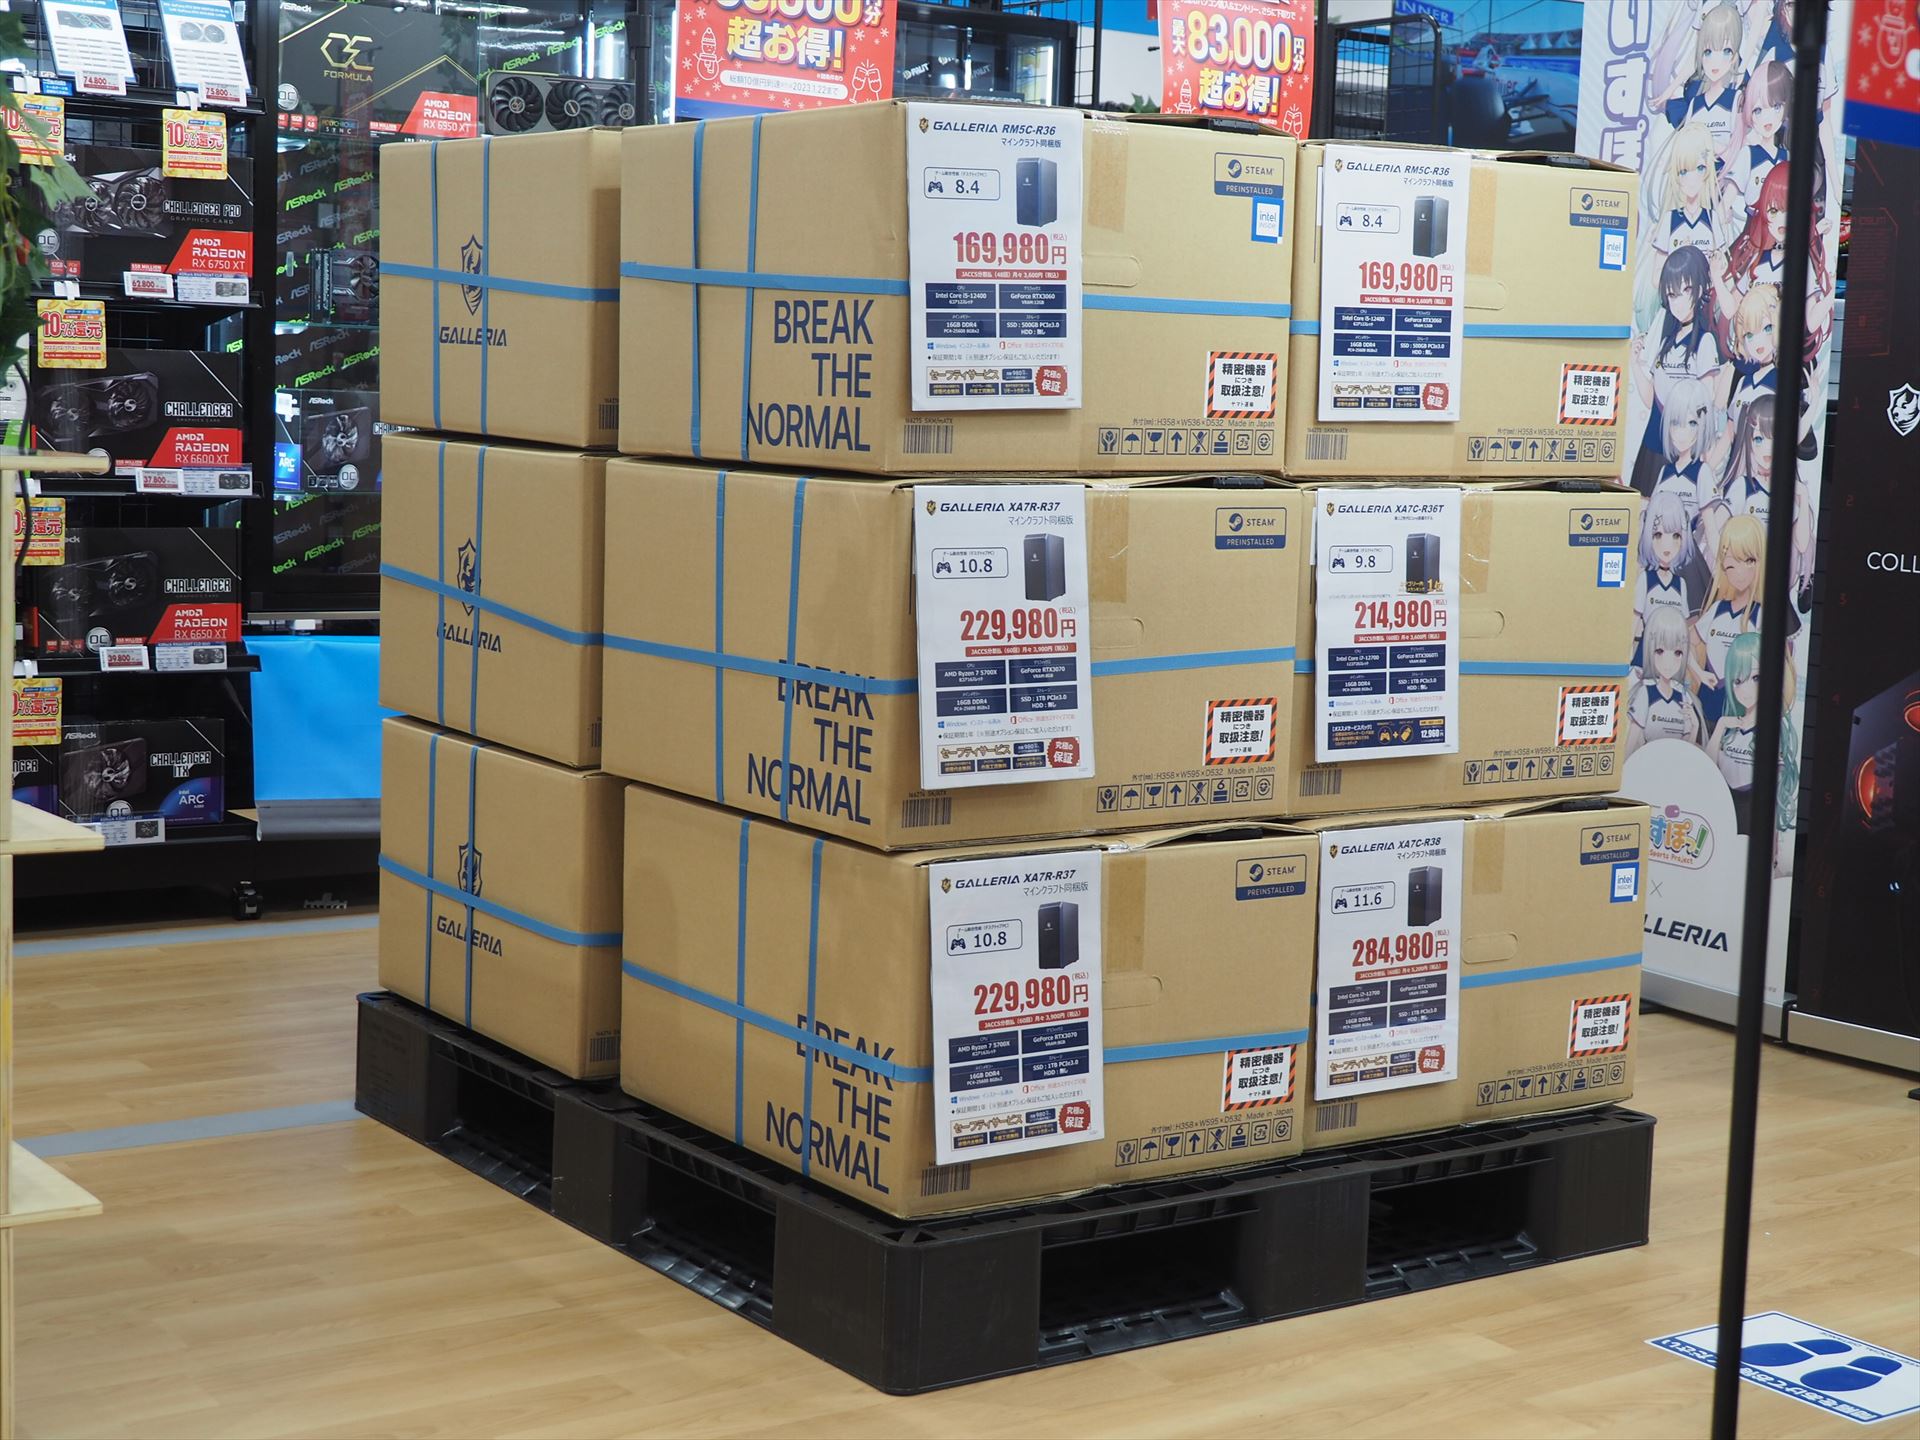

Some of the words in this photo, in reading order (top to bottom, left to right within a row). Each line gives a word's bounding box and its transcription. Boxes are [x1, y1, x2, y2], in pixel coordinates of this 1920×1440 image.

[280, 2, 312, 14] ASRock
[1172, 19, 1185, 54] 最大
[1187, 10, 1292, 74] 83,000
[728, 16, 844, 70] 超お得!
[1293, 37, 1305, 73] 円分
[502, 52, 541, 71] ASRock
[323, 70, 373, 82] FORMULA
[1200, 68, 1280, 113] 超お得!
[424, 99, 444, 108] AMD
[424, 108, 471, 121] RADEON
[424, 119, 435, 129] RX
[437, 120, 457, 131] 6950
[459, 122, 470, 133] XT
[933, 121, 998, 133] GALLERIA
[1002, 125, 1056, 136] RM5C-R36
[1244, 166, 1275, 176] STEAM
[1347, 162, 1401, 173] GALLERIA
[1404, 165, 1450, 176] RM5C-R36
[333, 171, 374, 193] ASRock
[955, 179, 979, 194] 8.4
[1226, 184, 1274, 196] PREINSTALLED
[286, 189, 327, 212] ASRock
[1595, 198, 1619, 209] STEAM
[163, 201, 221, 216] CHALLENGER
[223, 202, 241, 216] PRO
[1259, 211, 1277, 223] intel
[1362, 215, 1383, 227] 8.4
[1579, 216, 1620, 227] PREINSTALLED
[193, 238, 213, 246] AMD
[1606, 241, 1621, 252] intel
[192, 247, 246, 259] RADEON
[192, 259, 205, 269] RX
[208, 259, 230, 269] 6750
[232, 260, 245, 269] XT
[774, 299, 875, 344] BREAK
[439, 326, 507, 347] GALLERIA
[295, 364, 336, 388] ASRock
[811, 352, 872, 398] THE
[929, 369, 1000, 380] セーフティサービス
[1234, 376, 1253, 384] につき
[1042, 380, 1061, 393] 保証
[165, 402, 233, 417] CHALLENGER
[748, 403, 870, 452] NORMAL
[1228, 419, 1246, 428] Made
[1256, 420, 1275, 428] Japan
[175, 433, 197, 441] AMD
[175, 443, 229, 452] RADEON
[175, 454, 188, 463] RX
[190, 454, 215, 464] 6600
[217, 454, 229, 463] XT
[940, 503, 1005, 512] GALLERIA
[1008, 502, 1060, 512] XA7R-R37
[1338, 505, 1392, 514] GALLERIA
[1395, 505, 1445, 513] XA7C-R36T
[1246, 517, 1275, 528] STEAM
[1595, 518, 1621, 526] STEAM
[1226, 537, 1275, 546] PREINSTALLED
[1578, 536, 1620, 544] PREINSTALLED
[304, 537, 345, 562] ASRock
[959, 559, 992, 573] 10.8
[1356, 556, 1376, 568] 9.8
[1604, 559, 1620, 569] intel
[164, 578, 231, 593] CHALLENGER
[175, 609, 195, 617] AMD
[174, 619, 228, 628] RADEON
[174, 630, 188, 639] RX
[190, 630, 211, 639] 6650
[213, 630, 227, 639] XT
[1582, 707, 1598, 715] につき
[1232, 722, 1251, 730] につき
[65, 732, 97, 740] ASRock
[813, 717, 872, 773] THE
[940, 744, 1011, 758] セーフティサービス
[150, 752, 211, 766] CHALLENGER
[1053, 752, 1073, 764] 保証
[173, 765, 190, 778] ITX
[1227, 766, 1246, 776] Made
[1247, 766, 1255, 774] in
[1256, 765, 1276, 775] Japan
[748, 752, 871, 825] NORMAL
[179, 795, 205, 806] ARC
[1606, 833, 1631, 844] STEAM
[1341, 842, 1395, 854] GALLERIA
[1397, 837, 1441, 849] XA7C-R38
[1589, 851, 1630, 861] PREINSTALLED
[1671, 855, 1693, 865] Project
[1266, 865, 1296, 876] STEAM
[955, 875, 1020, 889] GALLERIA
[1024, 869, 1076, 883] XA7R-R37
[1617, 874, 1633, 885] intel
[1247, 885, 1295, 896] PREINSTALLED
[1354, 892, 1382, 907] 11.6
[974, 931, 1007, 948] 10.8
[1593, 1018, 1609, 1026] につき
[1252, 1066, 1270, 1075] につき
[832, 1078, 892, 1143] THE
[1065, 1116, 1084, 1128] 保証
[766, 1101, 889, 1195] NORMAL
